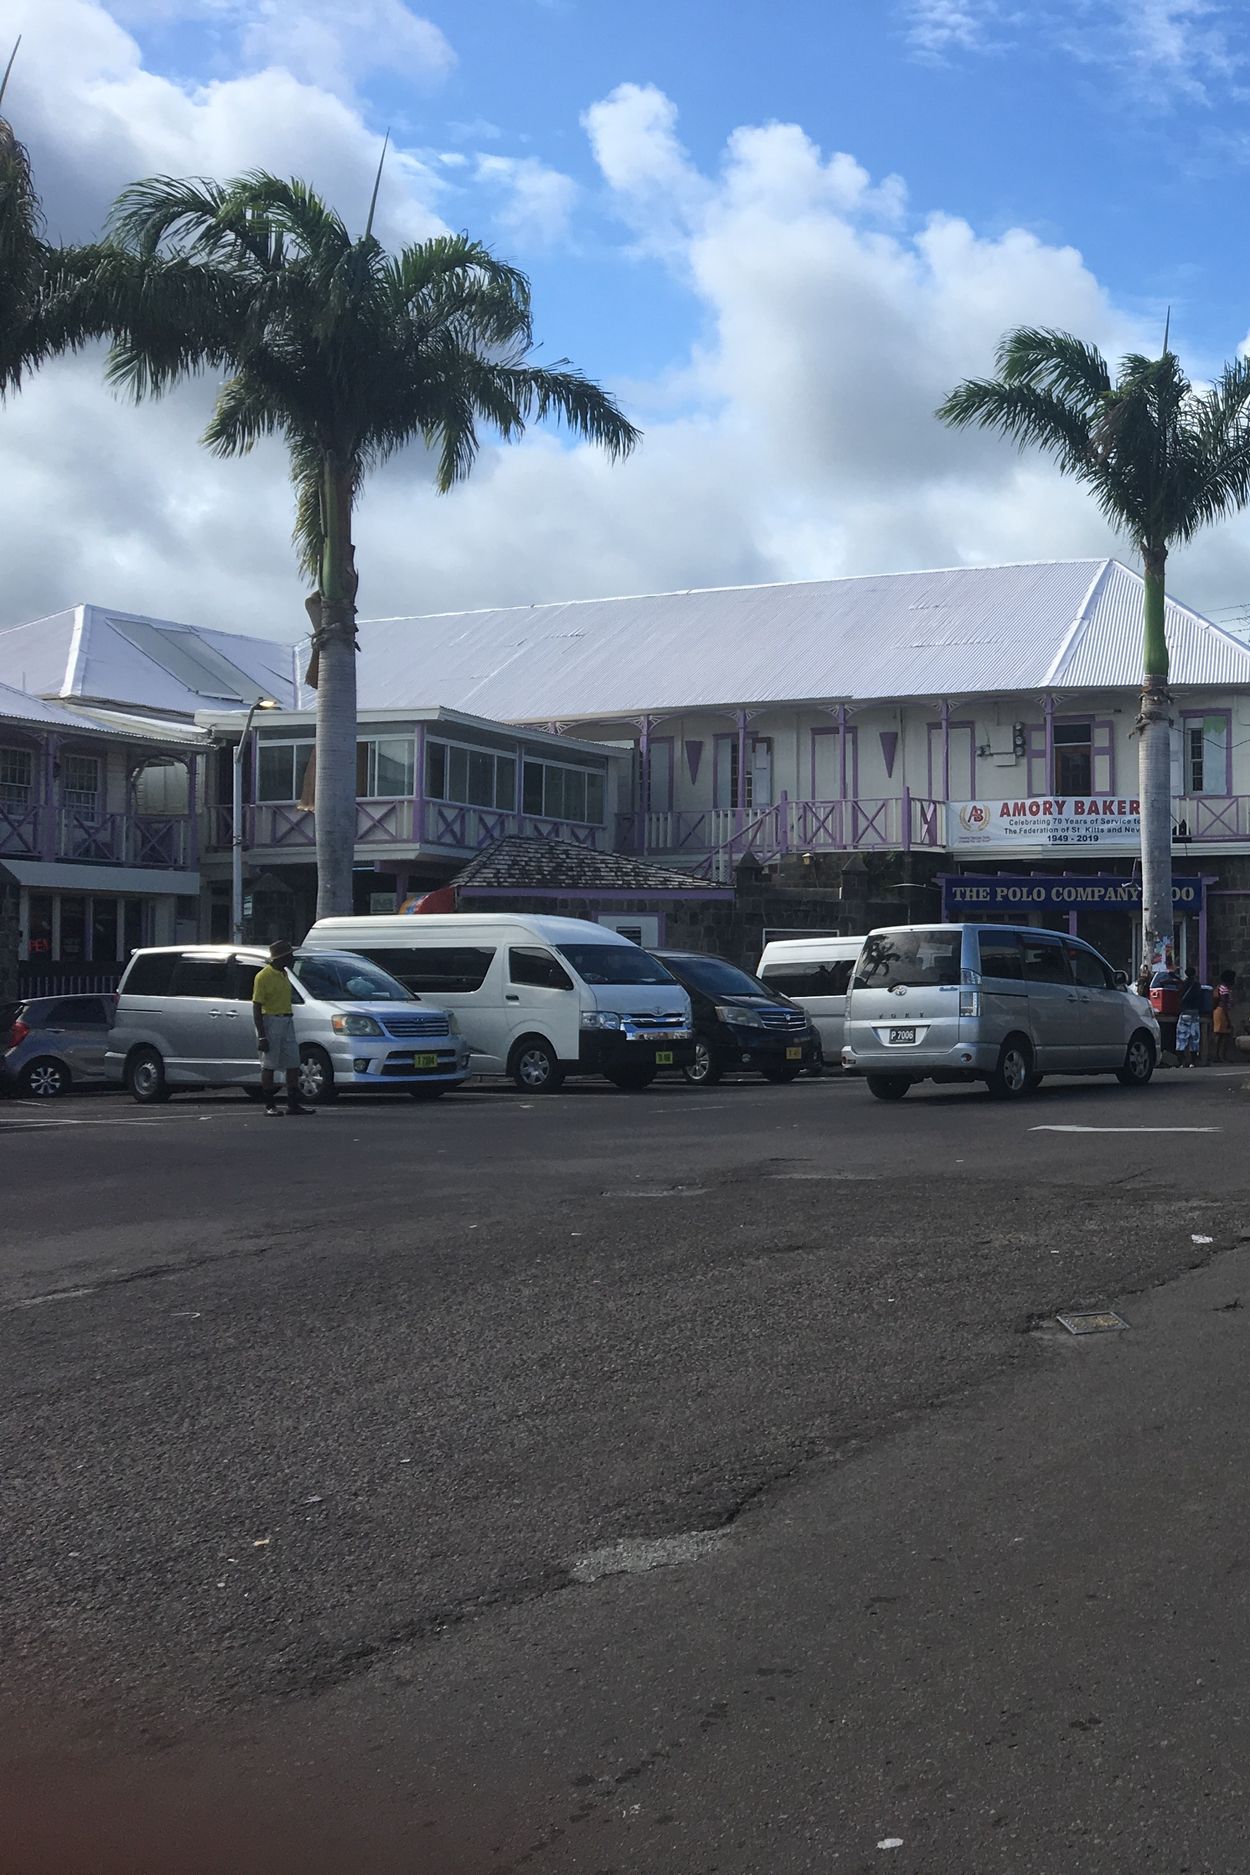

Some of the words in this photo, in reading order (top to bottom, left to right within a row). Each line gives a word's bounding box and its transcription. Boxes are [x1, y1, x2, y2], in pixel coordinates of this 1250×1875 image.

[999, 799, 1067, 817] AMORY
[1008, 819, 1051, 827] Celebrating
[1018, 826, 1059, 835] Federation
[1047, 835, 1069, 843] 1949
[1076, 834, 1099, 842] 2019
[952, 886, 990, 902] THE
[995, 886, 1046, 902] POLO
[1050, 886, 1139, 902] COMPANY
[890, 1030, 896, 1040] P
[897, 1030, 914, 1040] 7006
